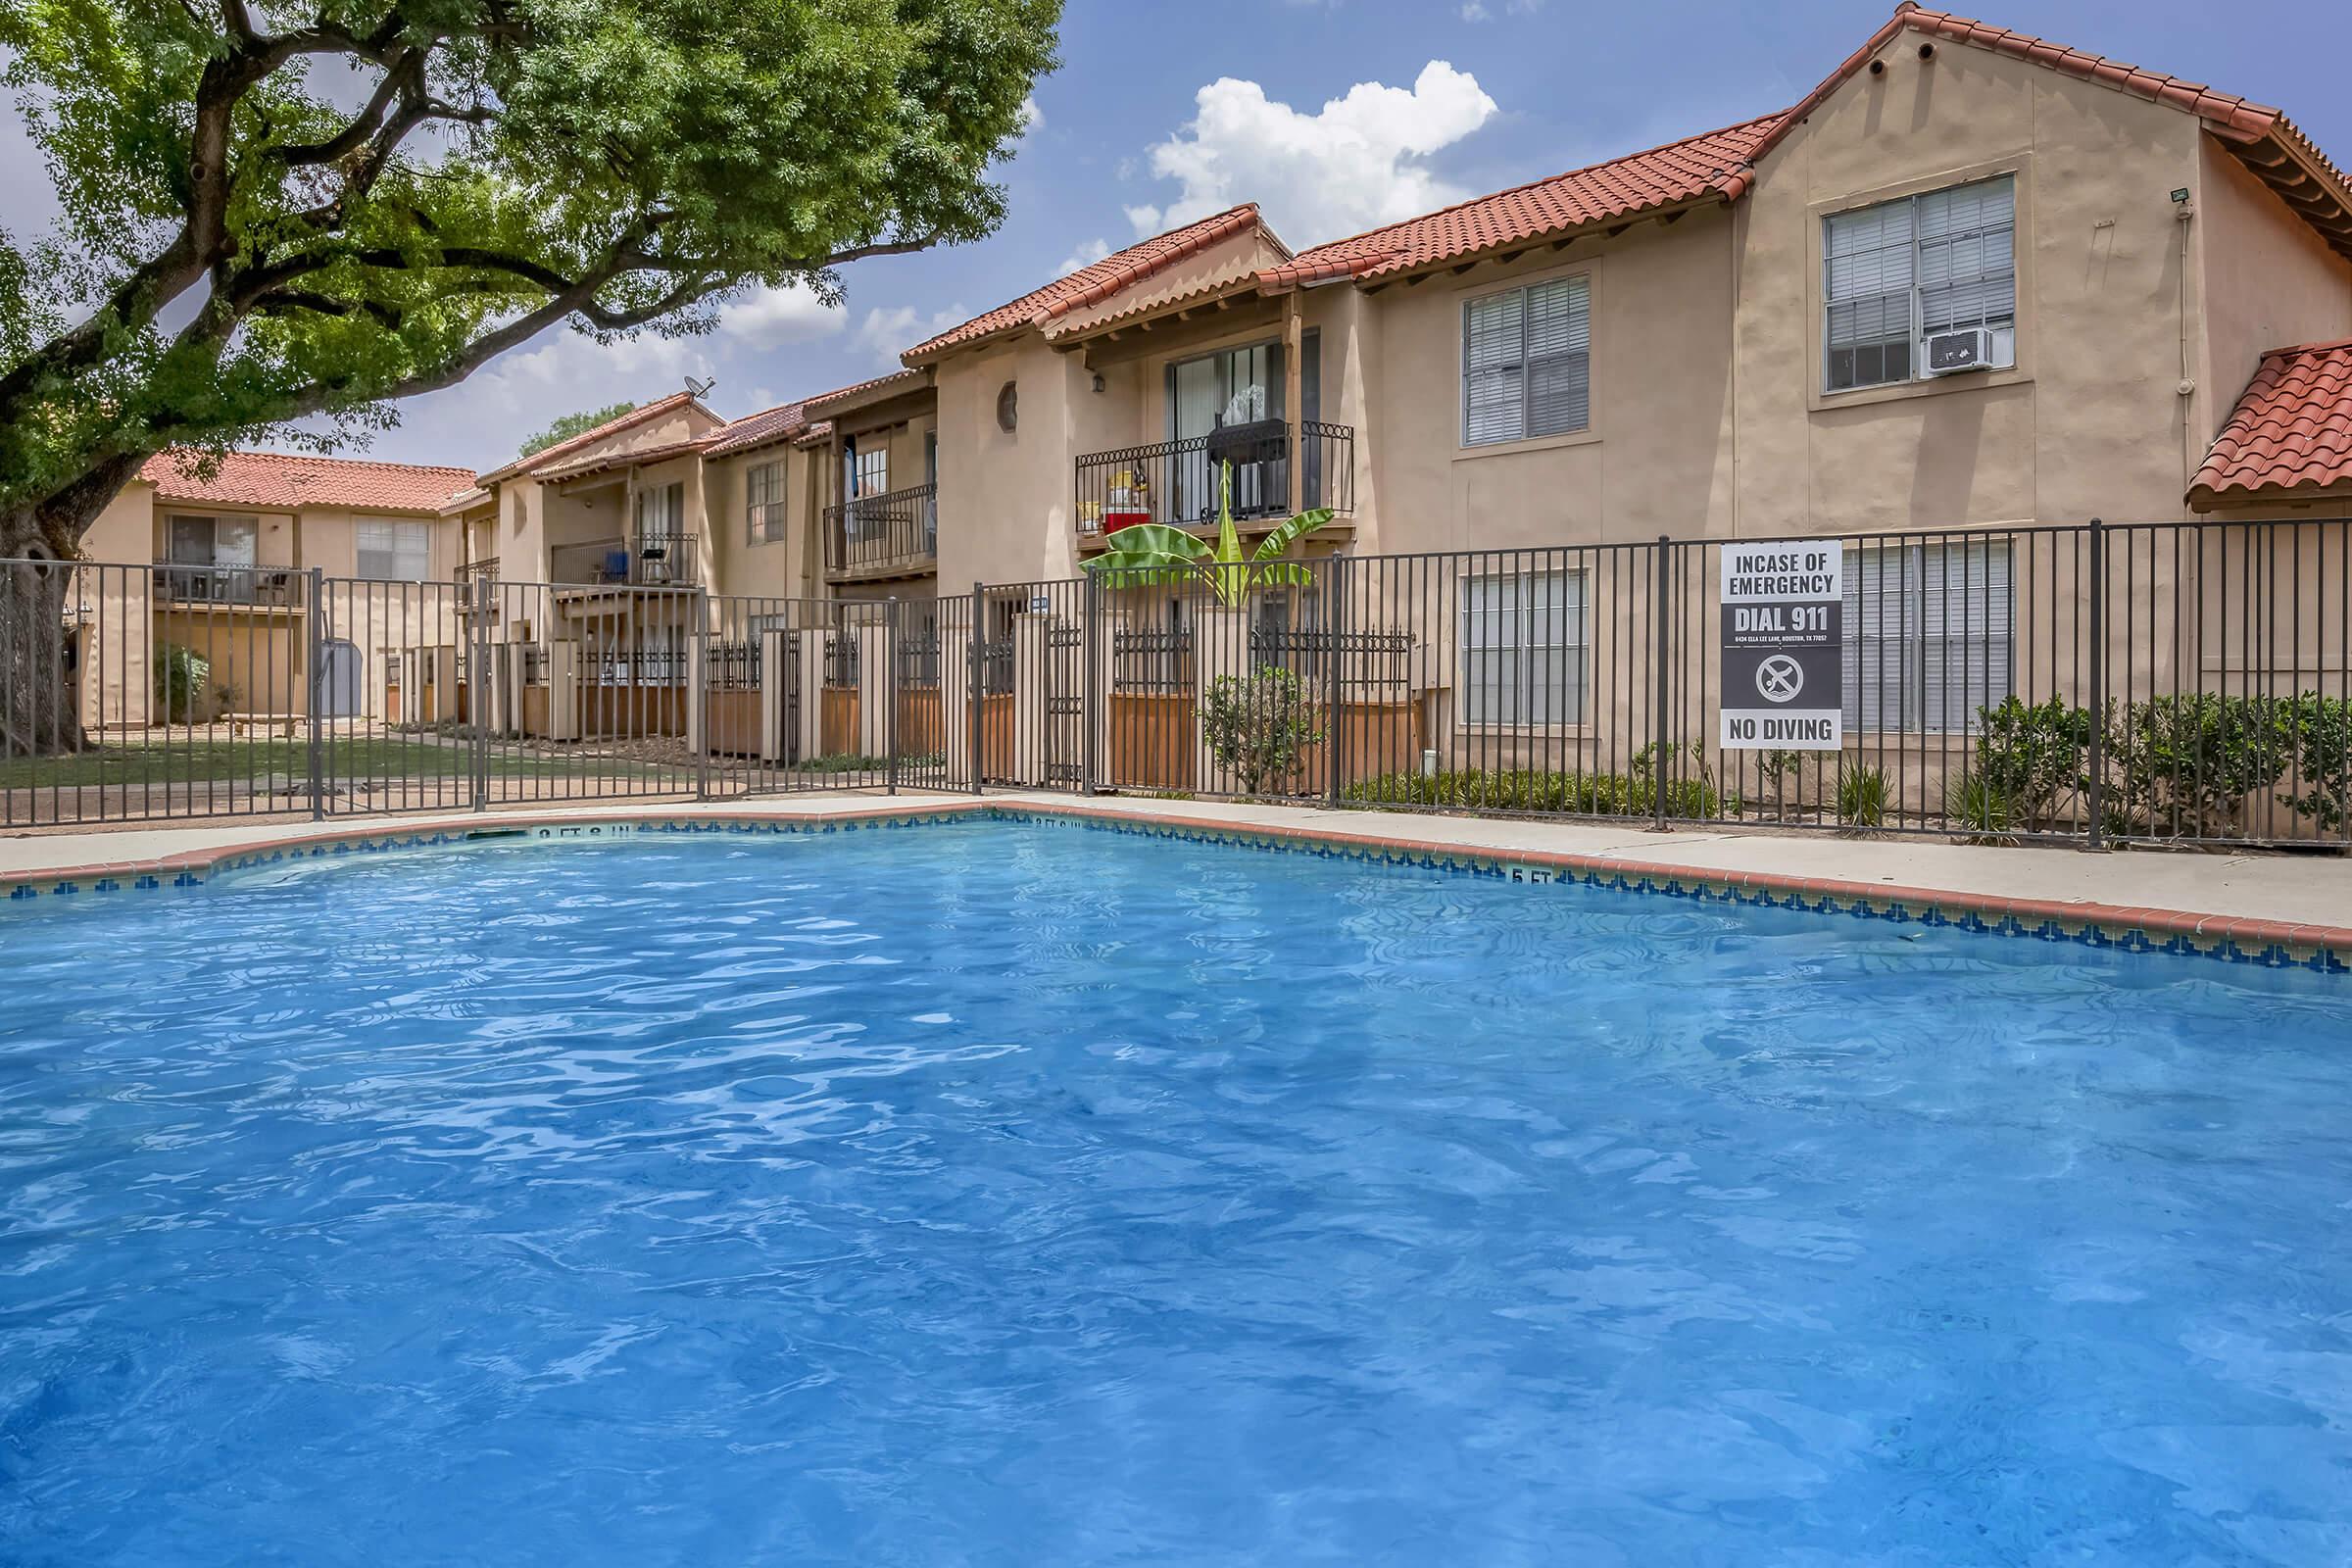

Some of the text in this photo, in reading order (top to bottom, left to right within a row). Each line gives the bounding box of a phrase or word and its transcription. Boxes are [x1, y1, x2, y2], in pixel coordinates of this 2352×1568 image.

[1736, 553, 1828, 574] INCASE OF
[1730, 574, 1834, 596] EMERGENCY
[1735, 606, 1828, 632] DIAL 911
[1730, 717, 1833, 740] NO DIVING
[1512, 868, 1551, 883] 5 FT
